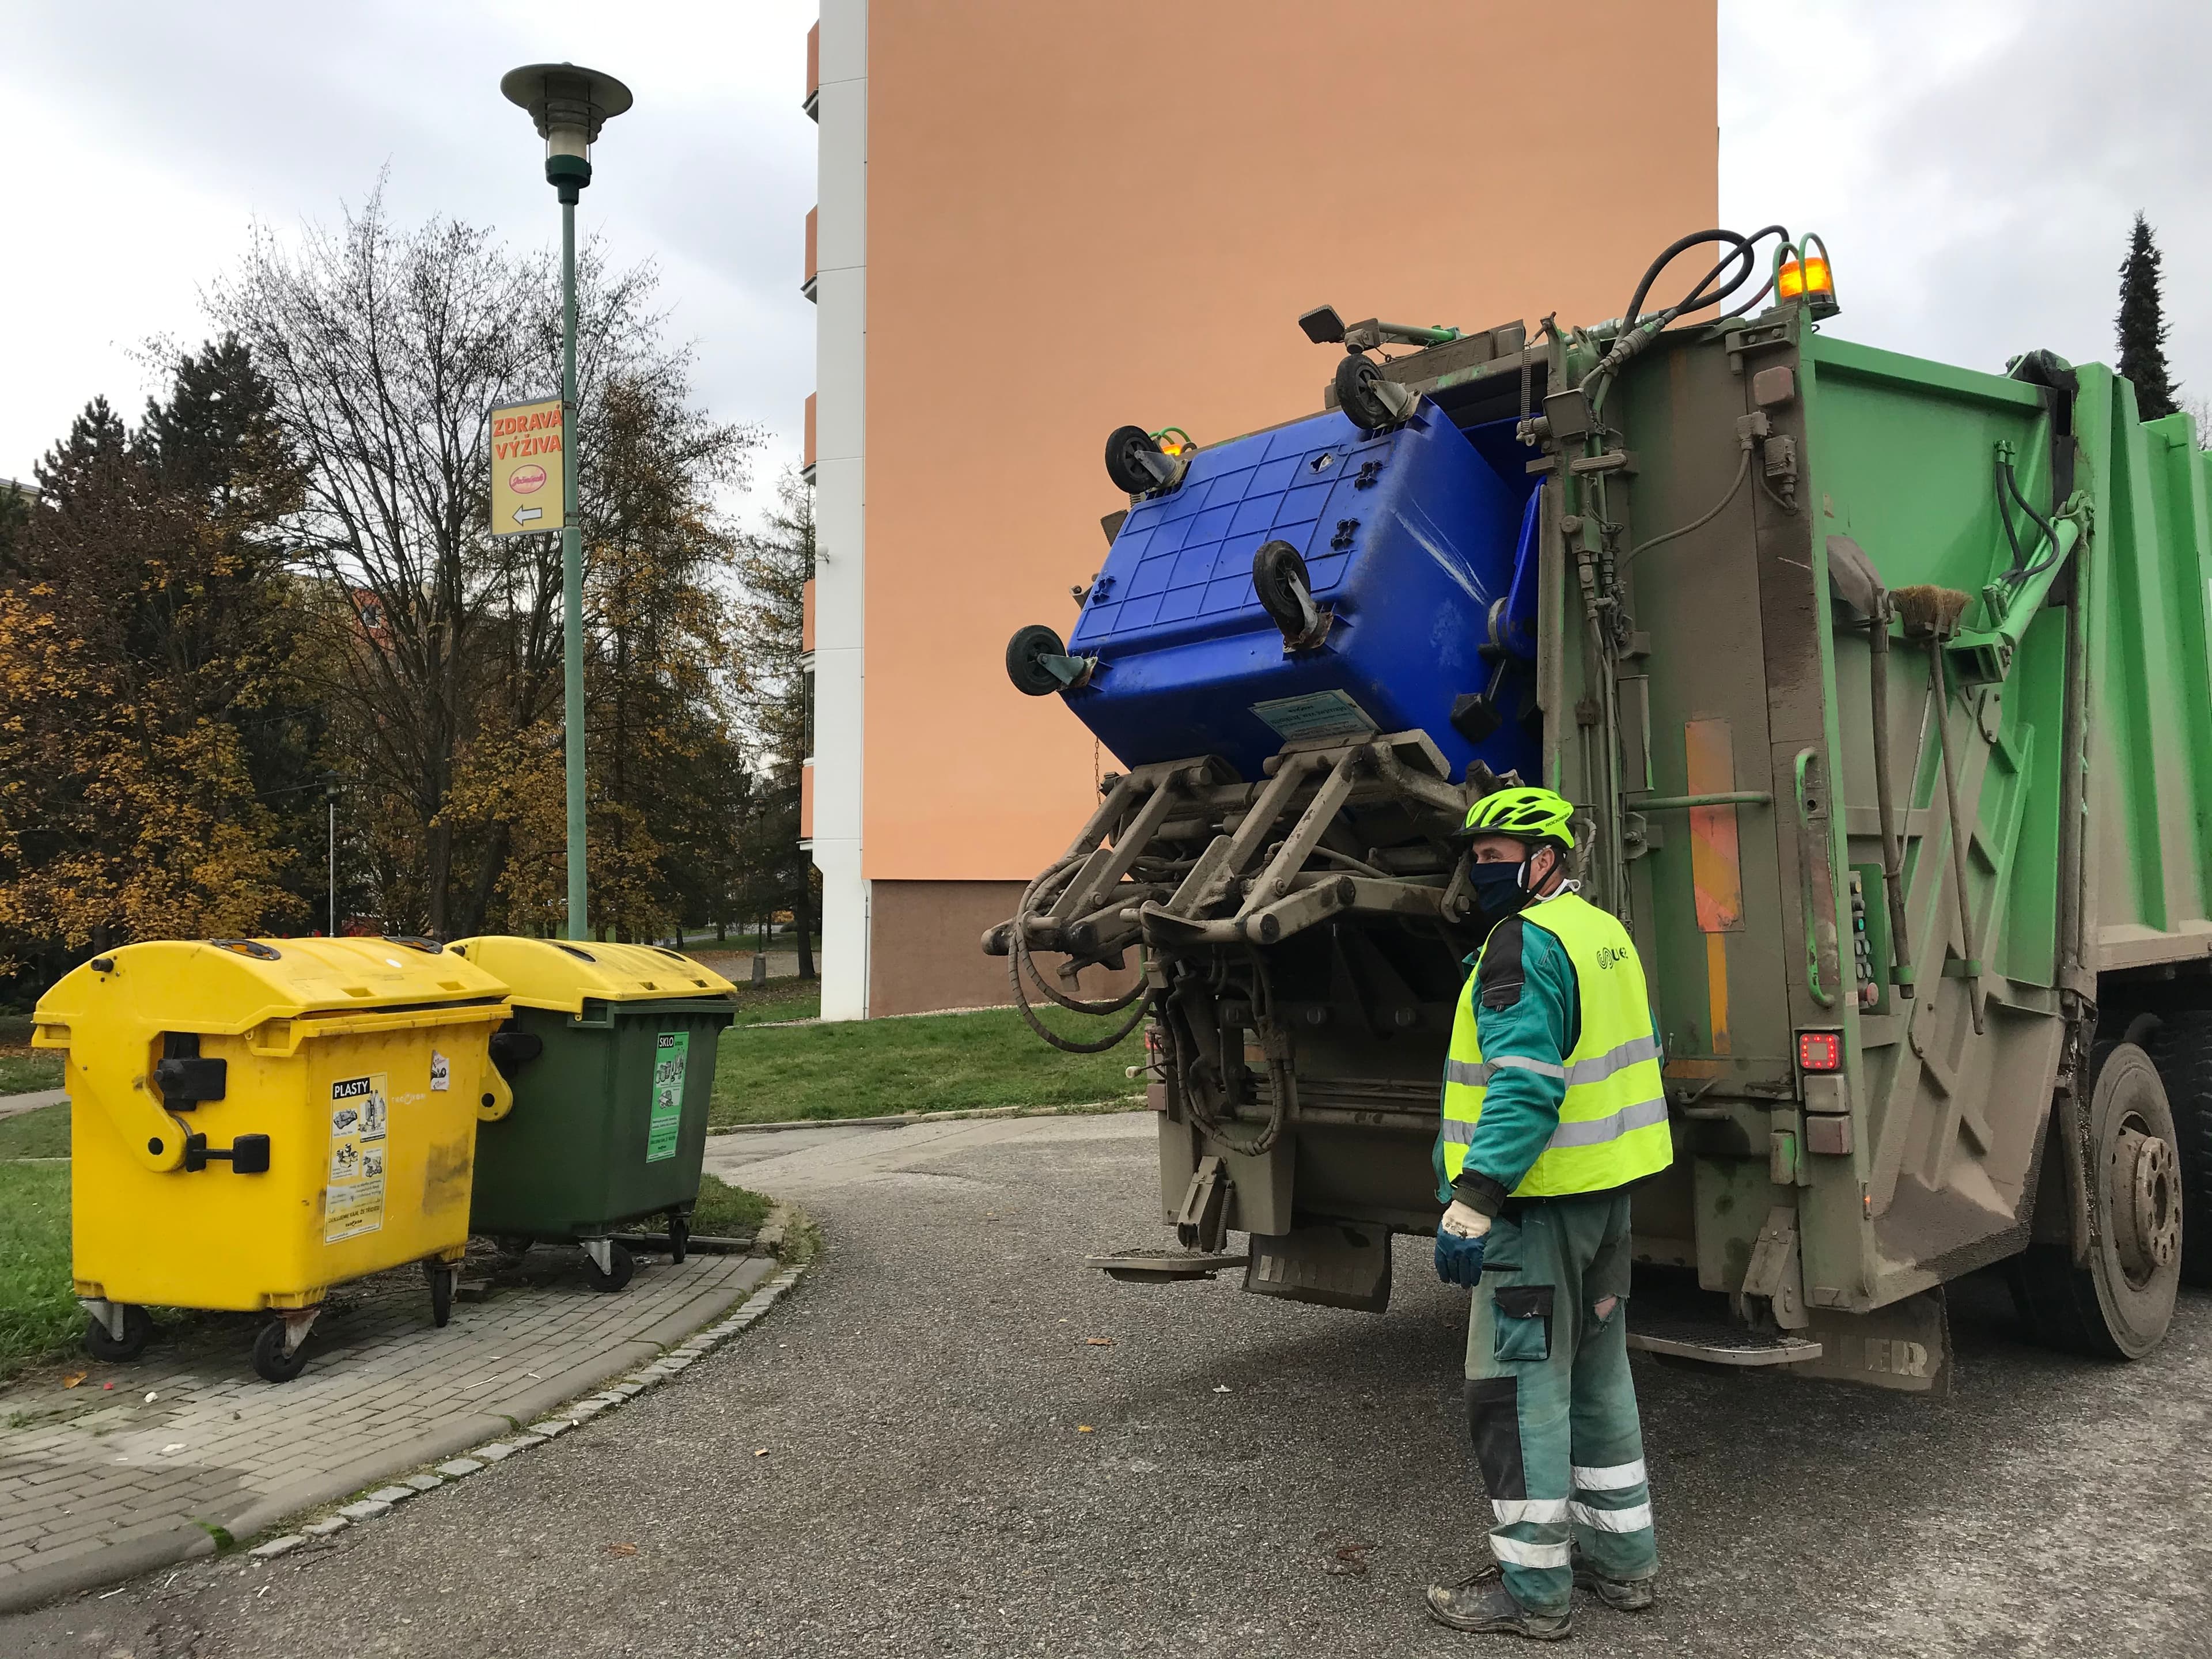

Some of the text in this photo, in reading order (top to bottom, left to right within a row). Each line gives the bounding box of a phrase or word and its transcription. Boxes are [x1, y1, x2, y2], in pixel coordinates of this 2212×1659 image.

[493, 404, 562, 437] ZDRAVÁ
[495, 434, 562, 460] VÝŽIVA
[659, 1036, 674, 1047] SKLO
[334, 1080, 368, 1098] PLASTY
